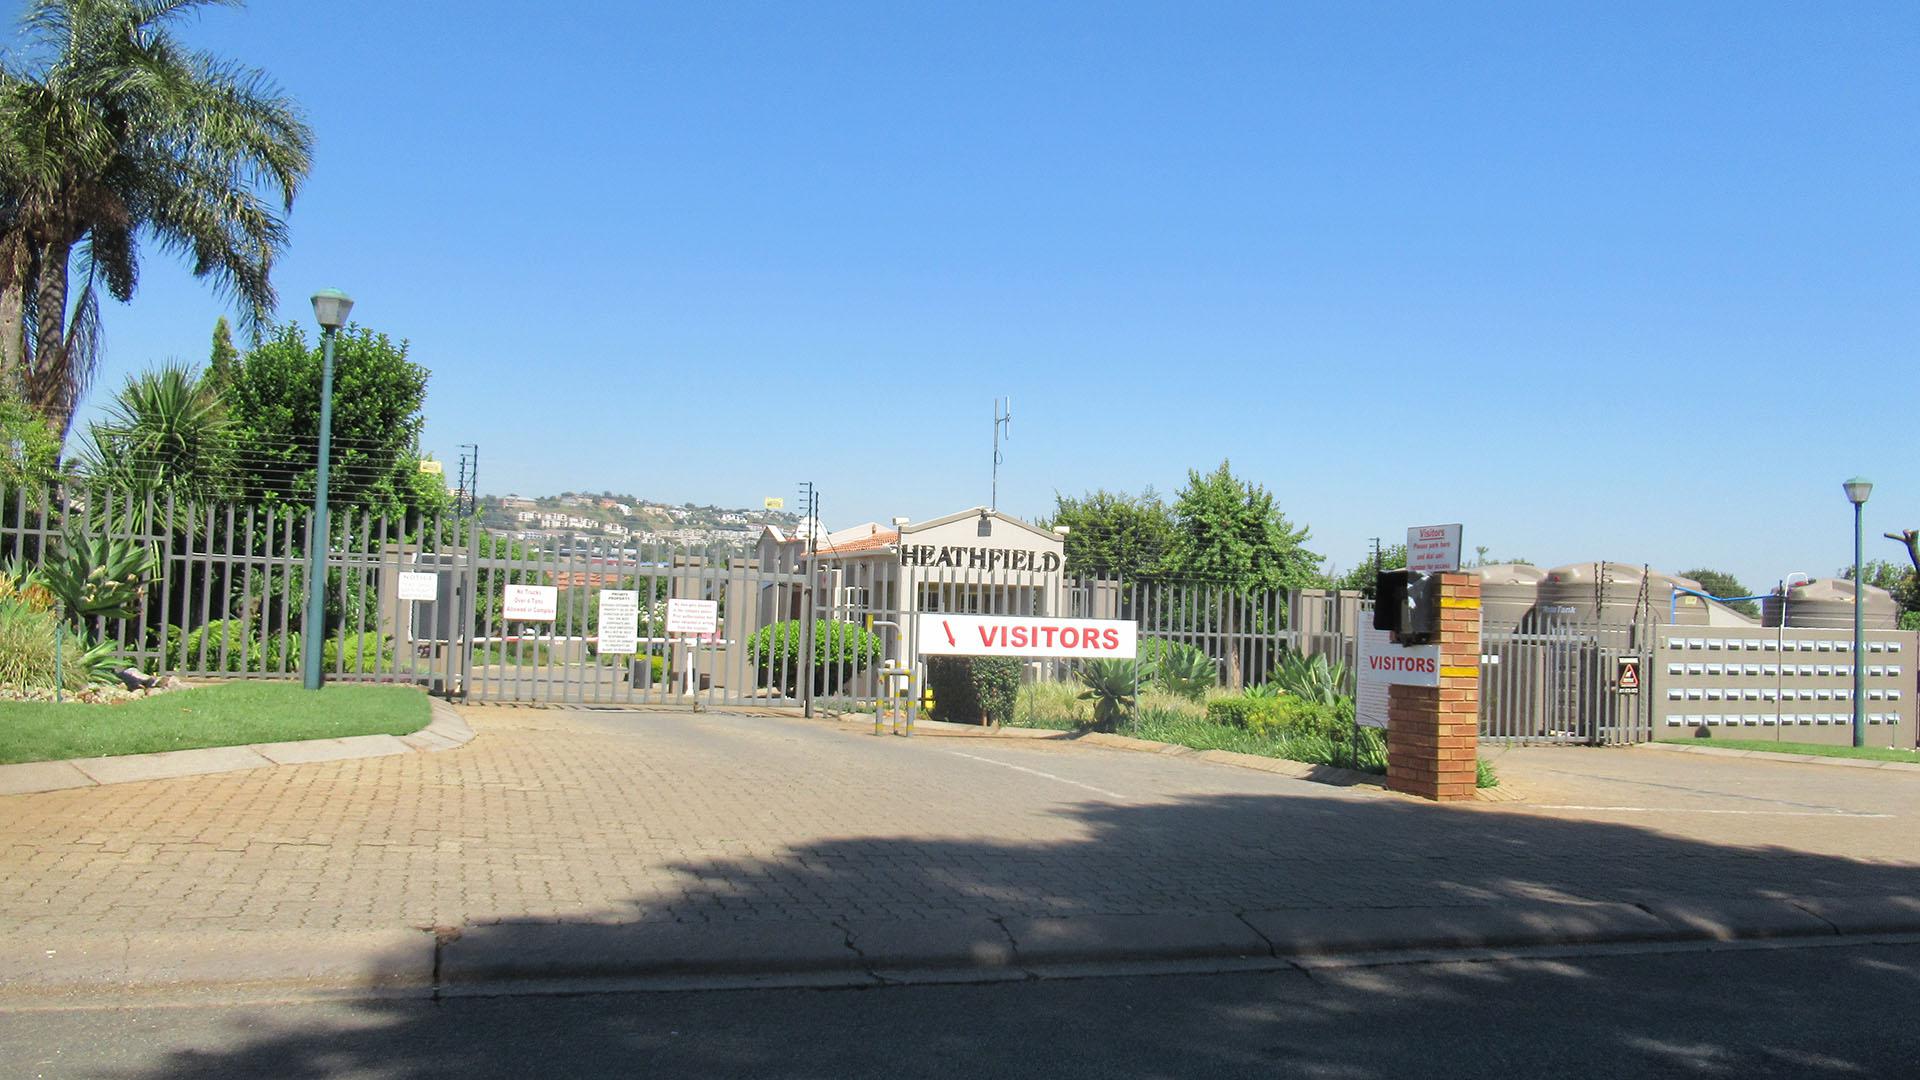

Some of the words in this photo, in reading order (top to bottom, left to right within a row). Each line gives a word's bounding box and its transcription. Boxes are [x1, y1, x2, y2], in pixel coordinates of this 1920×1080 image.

[1420, 528, 1444, 538] Visitors
[901, 544, 1061, 573] HEATHFIELD
[978, 625, 1119, 649] VISITORS
[1369, 655, 1435, 673] VISITORS
